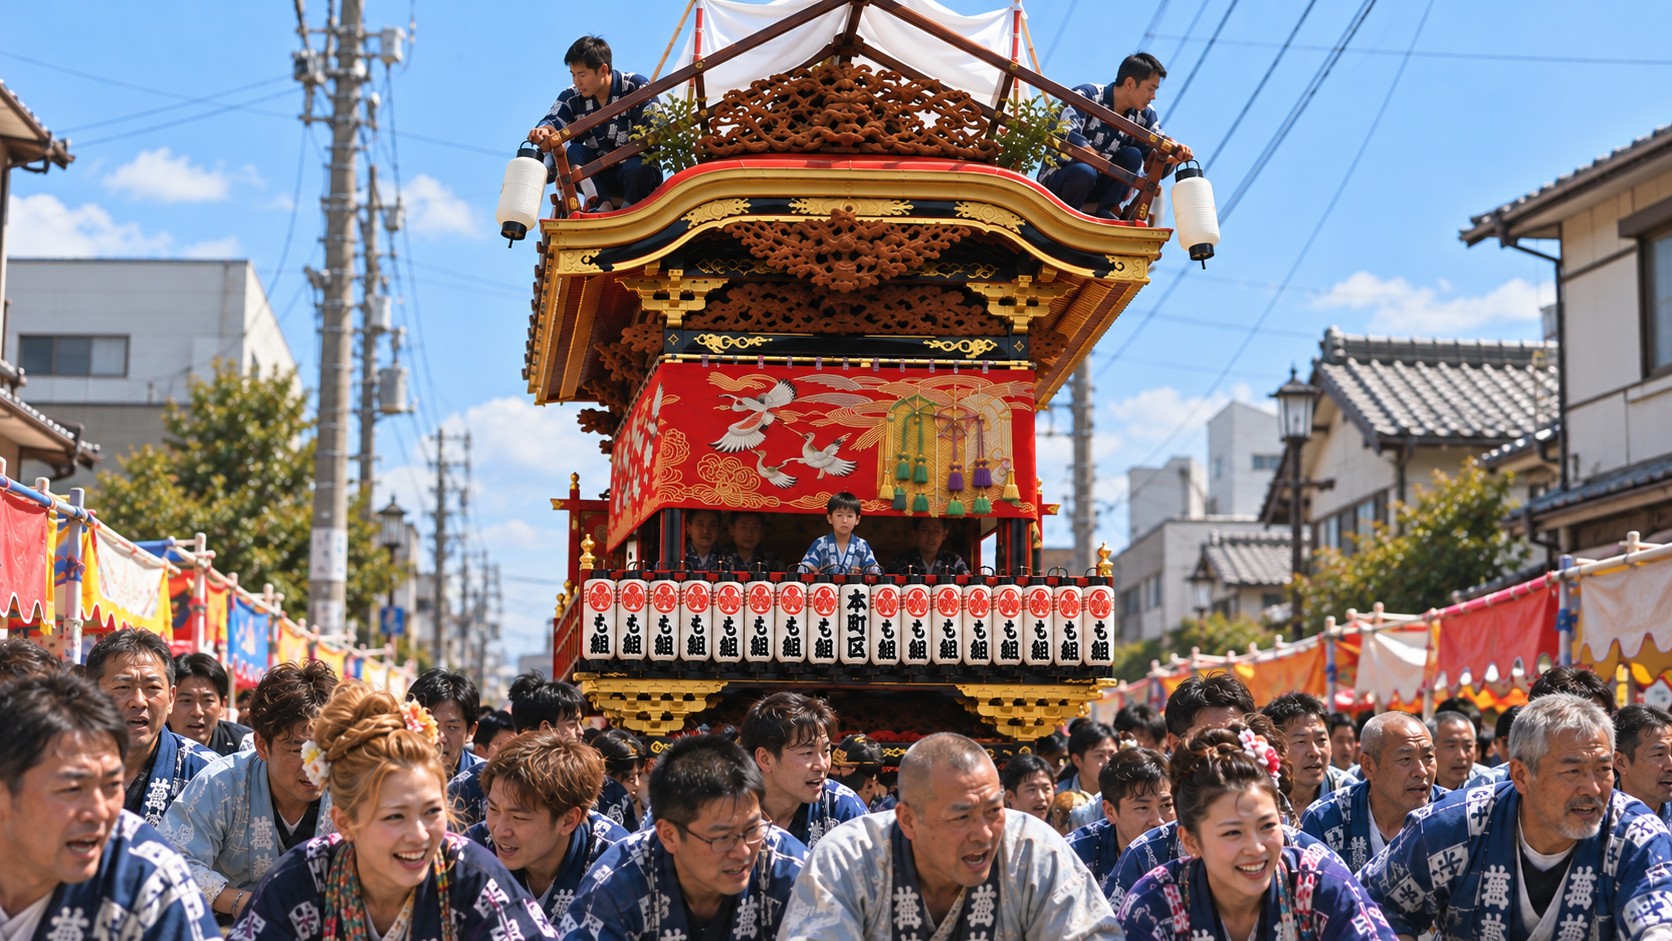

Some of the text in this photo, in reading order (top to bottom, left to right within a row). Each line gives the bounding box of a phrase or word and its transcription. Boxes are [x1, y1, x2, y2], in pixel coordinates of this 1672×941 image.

[590, 613, 610, 655] も組
[622, 614, 642, 655] も組
[655, 614, 674, 656] も組
[687, 615, 706, 655] も組
[719, 616, 738, 657] も組
[751, 616, 770, 657] も組
[782, 616, 801, 657] も組
[815, 618, 834, 658] も組
[847, 589, 867, 658] 本町区
[878, 619, 896, 660] も組
[909, 619, 927, 659] も組
[940, 619, 958, 659] も組
[970, 620, 988, 660] も組
[1001, 620, 1019, 660] も組
[1031, 620, 1049, 660] も組
[1061, 621, 1079, 660] も組
[1091, 621, 1110, 660] も組
